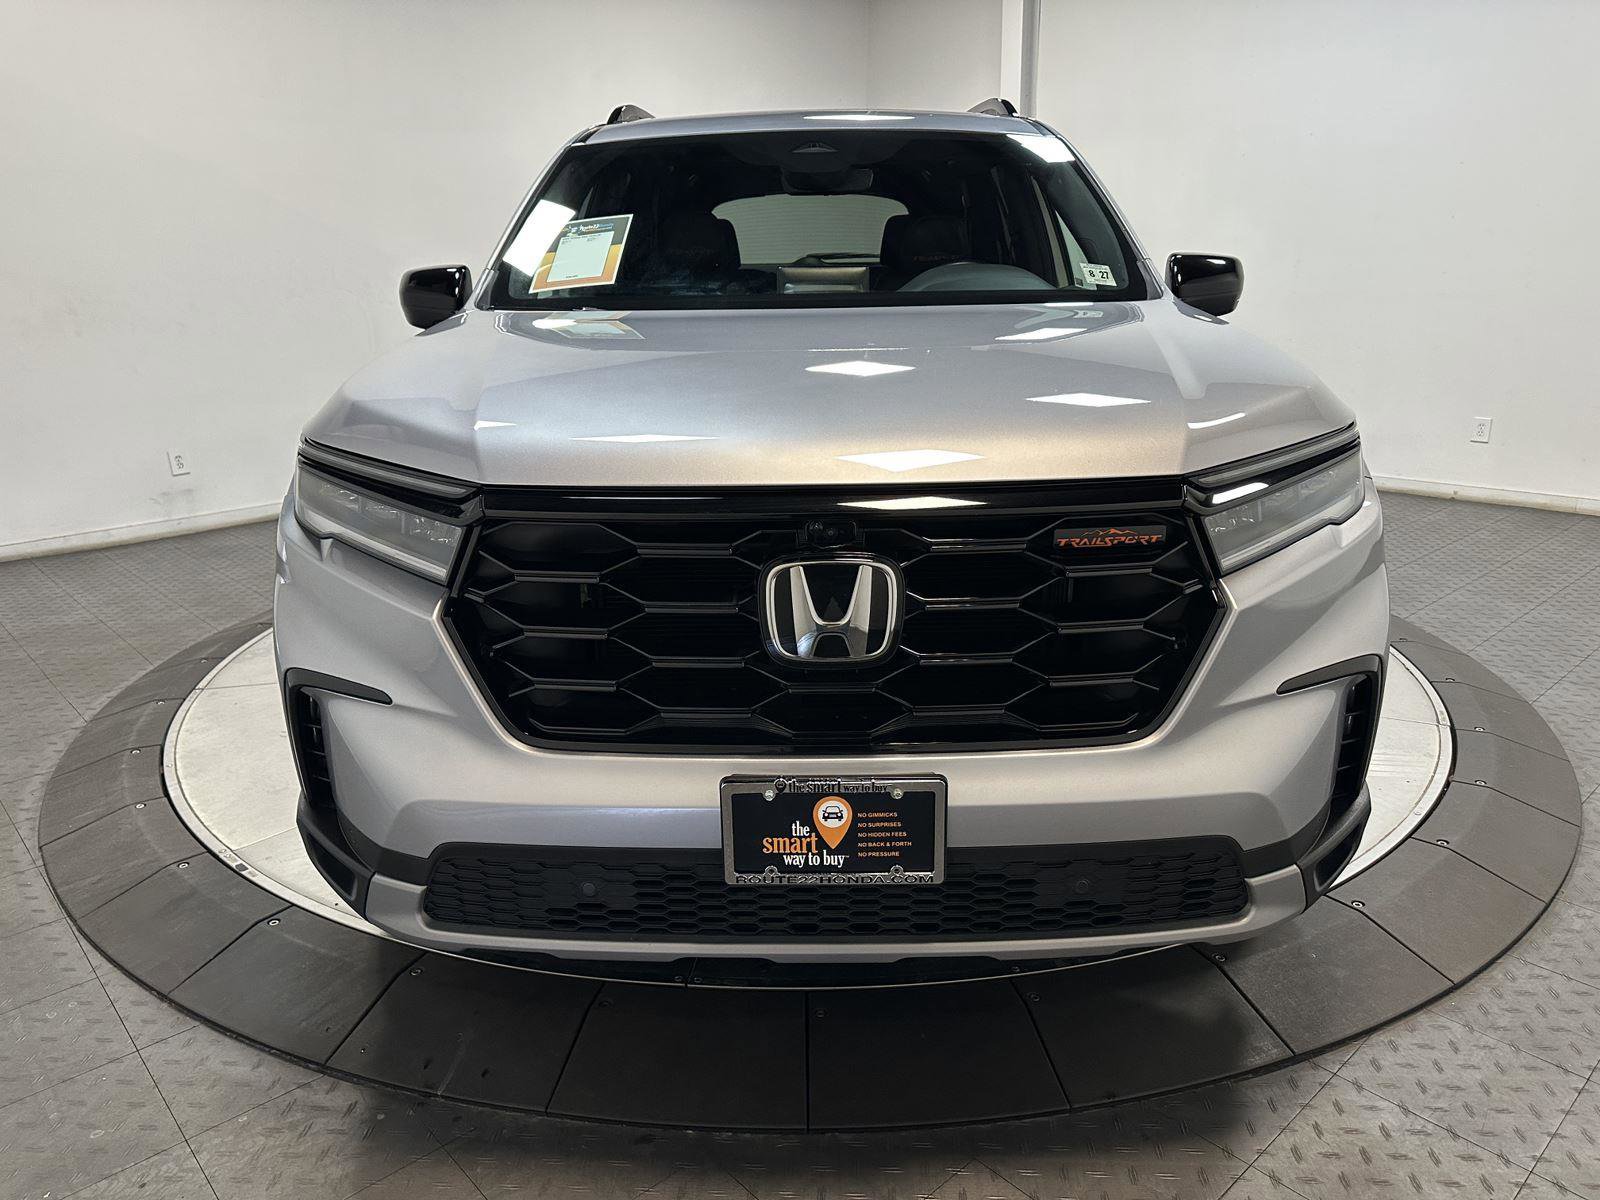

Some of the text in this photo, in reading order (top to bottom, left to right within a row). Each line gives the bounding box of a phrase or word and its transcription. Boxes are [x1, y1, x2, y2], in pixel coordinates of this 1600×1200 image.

[1088, 269, 1109, 280] 8 27
[1056, 534, 1162, 548] TRAILSPORT
[788, 780, 805, 793] the
[806, 780, 841, 793] smart
[843, 784, 859, 794] way
[791, 820, 810, 837] the
[762, 832, 819, 854] smart
[782, 849, 845, 868] way to buy
